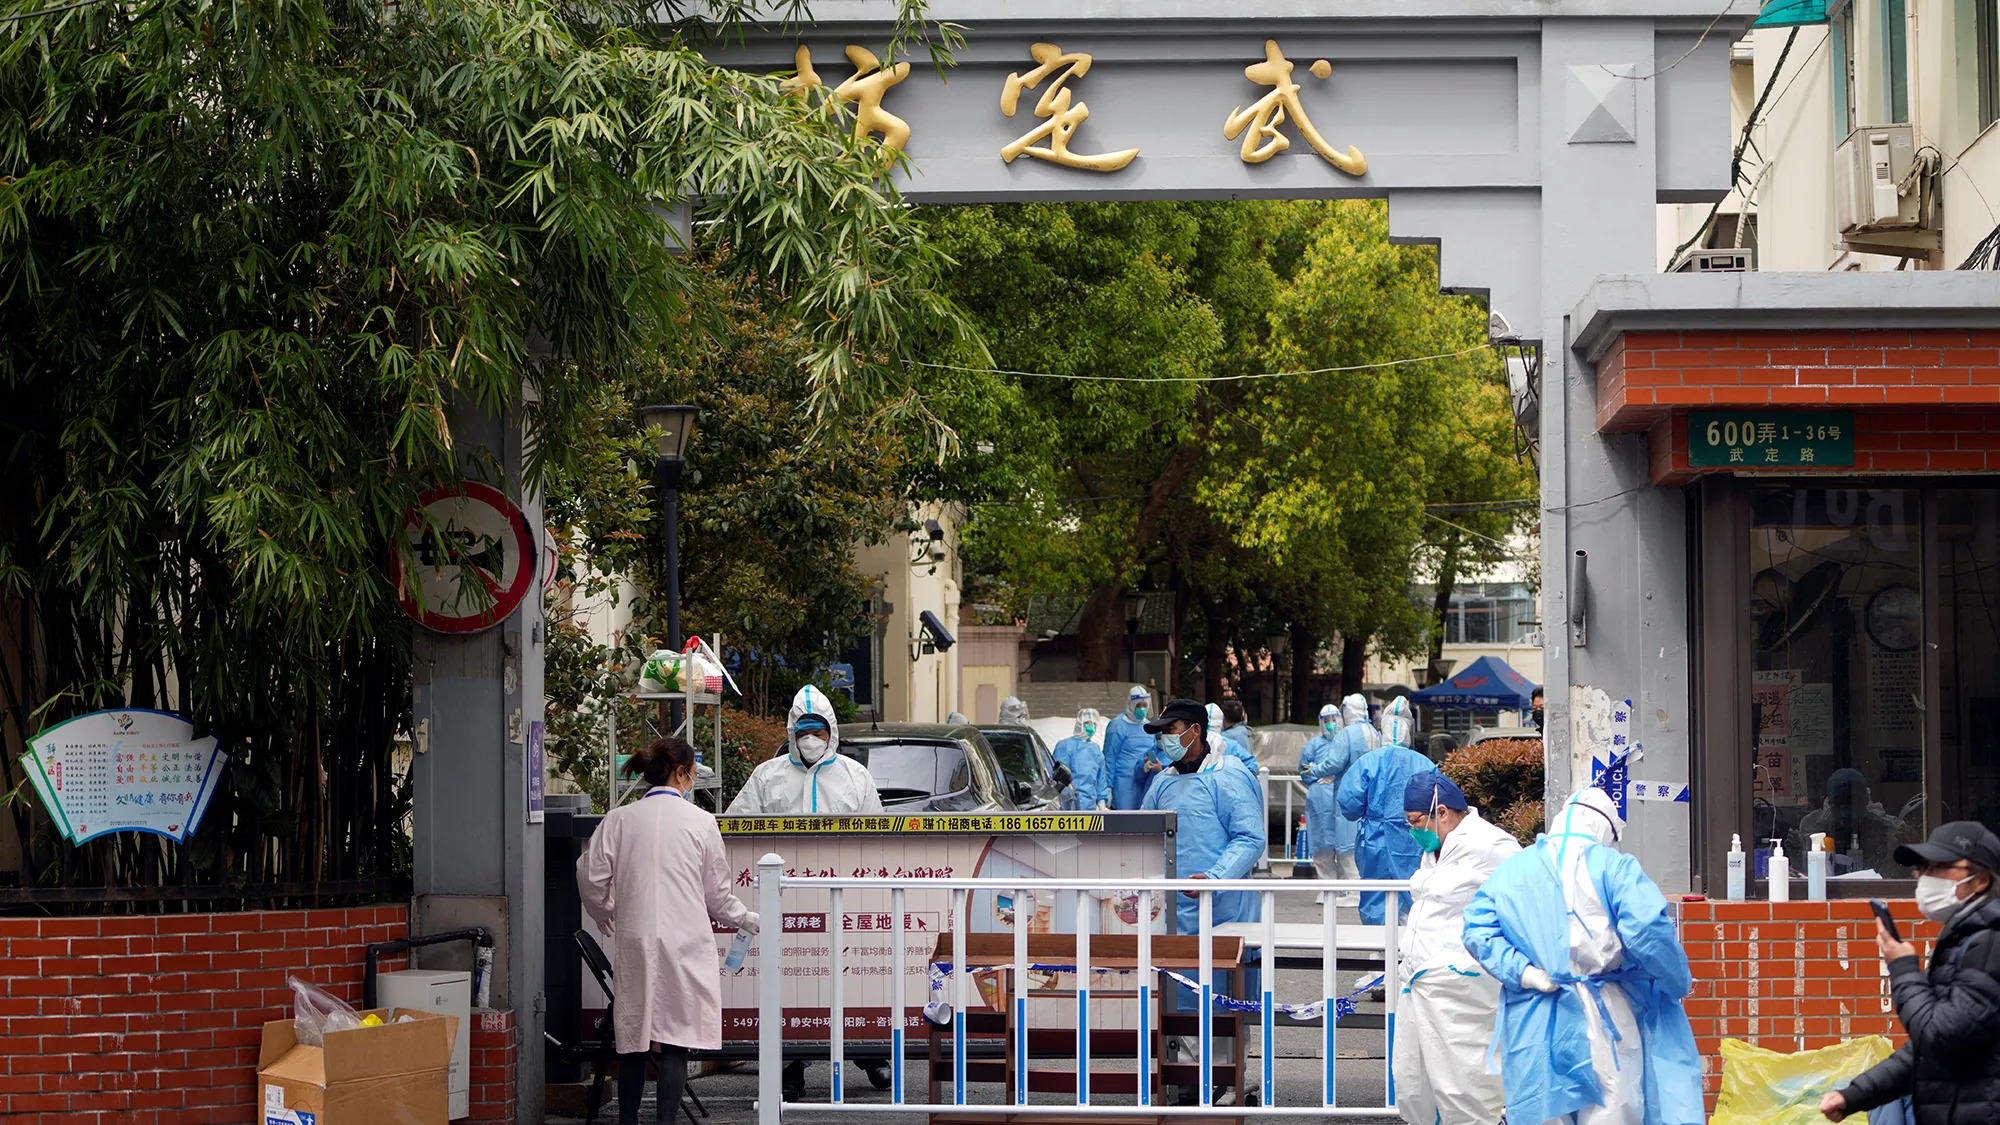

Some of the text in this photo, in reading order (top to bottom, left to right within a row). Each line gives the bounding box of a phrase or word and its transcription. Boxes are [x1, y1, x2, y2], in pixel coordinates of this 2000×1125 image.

[1706, 421, 1841, 446] 600弄 1-36号
[1729, 447, 1815, 462] 武定路
[116, 753, 135, 762] 富强
[139, 753, 157, 762] 民主
[161, 753, 180, 762] 文明
[184, 753, 203, 762] 和谐
[116, 764, 135, 773] 自由
[139, 764, 157, 773] 平等
[161, 764, 180, 773] 公正
[184, 764, 203, 773] 法治
[116, 775, 135, 784] 爱国
[139, 775, 157, 784] 敬业
[161, 775, 180, 784] 诚信
[184, 775, 203, 784] 友善
[1635, 783, 1669, 797] 警察
[159, 792, 195, 805] 有你有我
[728, 819, 779, 831] 请勿跟车
[782, 819, 834, 831] 如若撞杆
[838, 819, 891, 831] 照价赔偿
[1000, 818, 1021, 830] 186
[1026, 818, 1054, 830] 1657
[1058, 818, 1084, 830] 6111
[782, 916, 822, 929] 家养老
